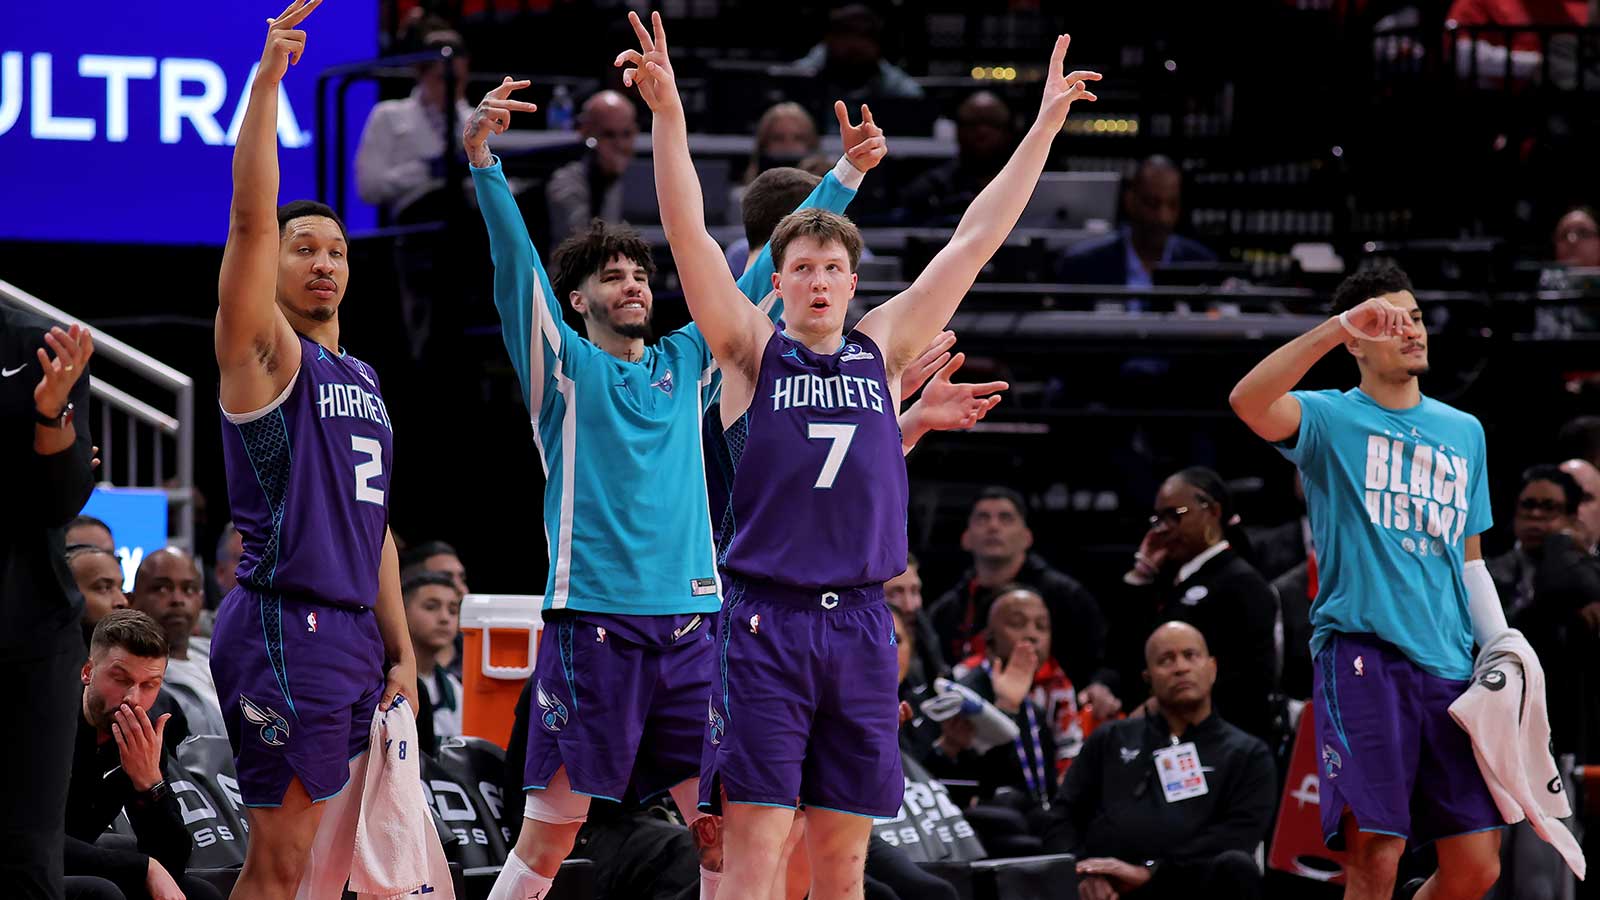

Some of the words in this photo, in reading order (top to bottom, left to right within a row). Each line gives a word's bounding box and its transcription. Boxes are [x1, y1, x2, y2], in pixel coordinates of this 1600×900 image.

[316, 383, 393, 433] HORNET
[770, 374, 885, 415] HORNETS
[351, 433, 385, 507] 2
[807, 423, 859, 489] 7
[1365, 434, 1468, 512] BLACK
